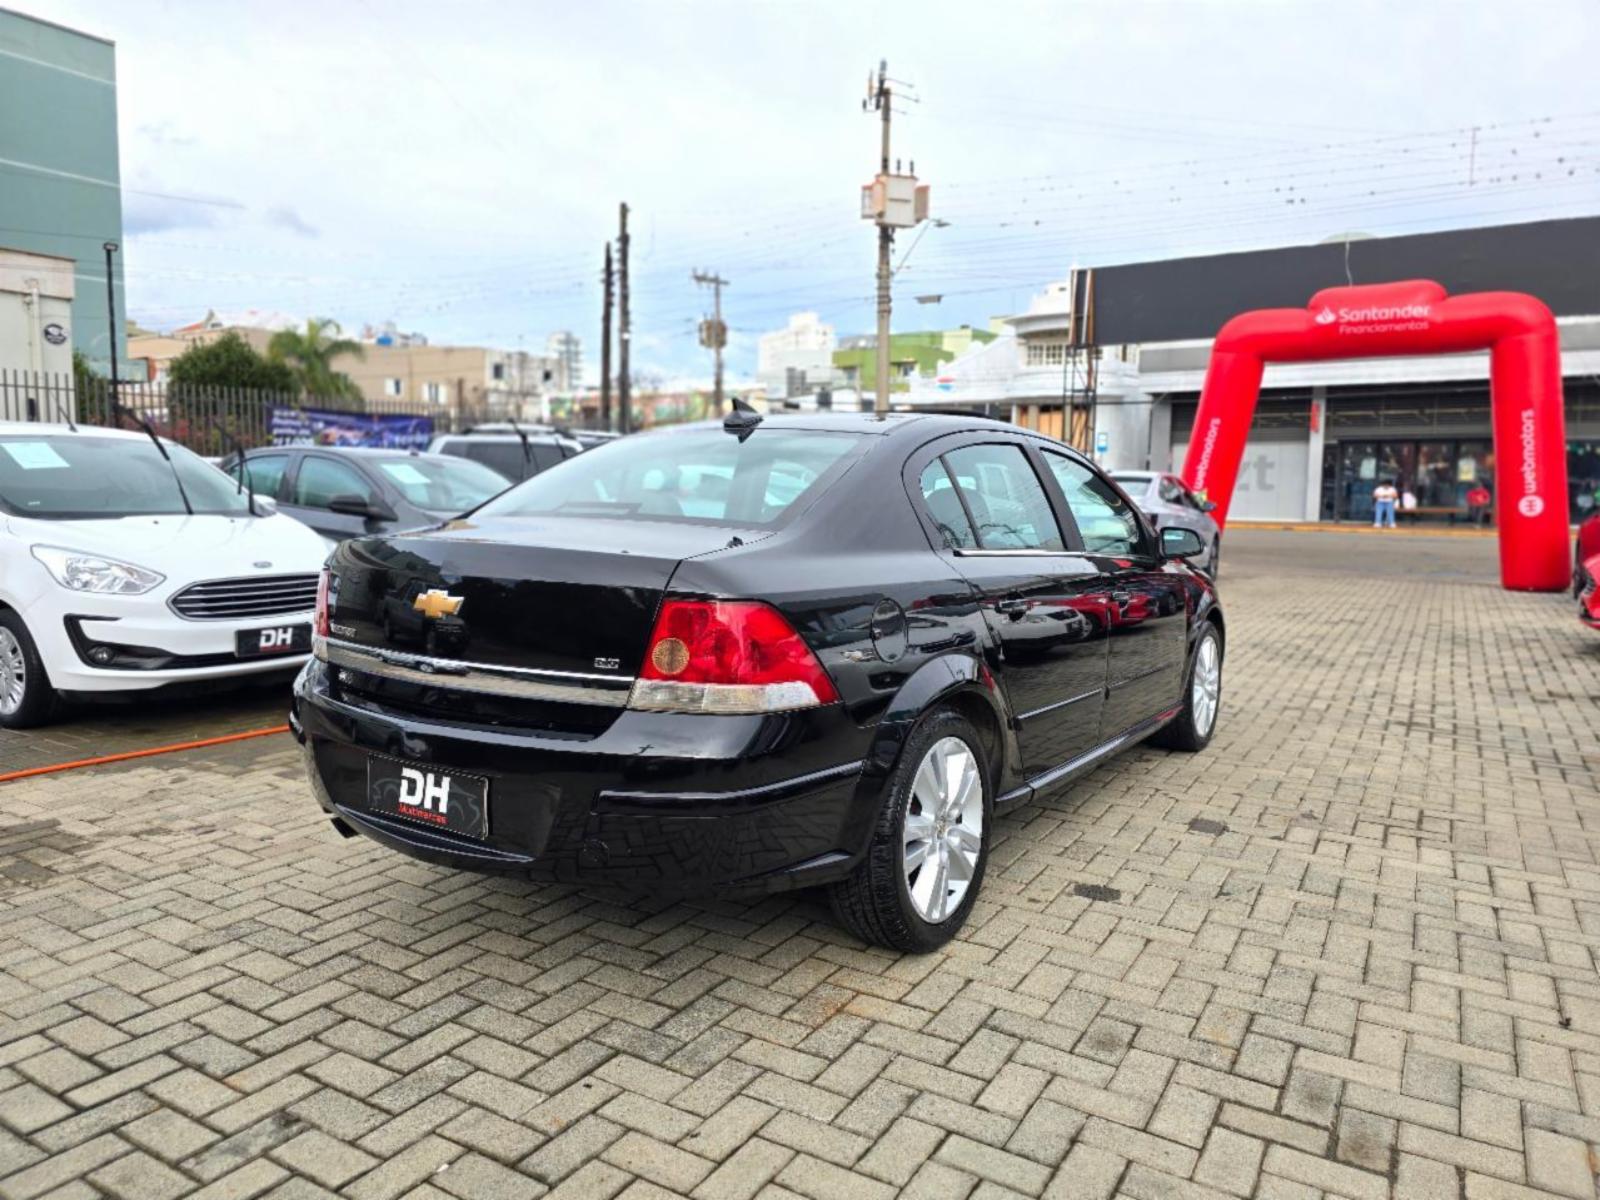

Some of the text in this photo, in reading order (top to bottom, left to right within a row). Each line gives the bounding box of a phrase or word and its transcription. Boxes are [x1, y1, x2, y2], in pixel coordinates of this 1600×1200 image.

[1339, 305, 1431, 323] Santander
[1339, 321, 1429, 335] Financiamentos
[1193, 417, 1221, 490] webmotors
[1521, 409, 1537, 494] webmotors
[259, 626, 294, 648] DH
[399, 766, 451, 814] DH
